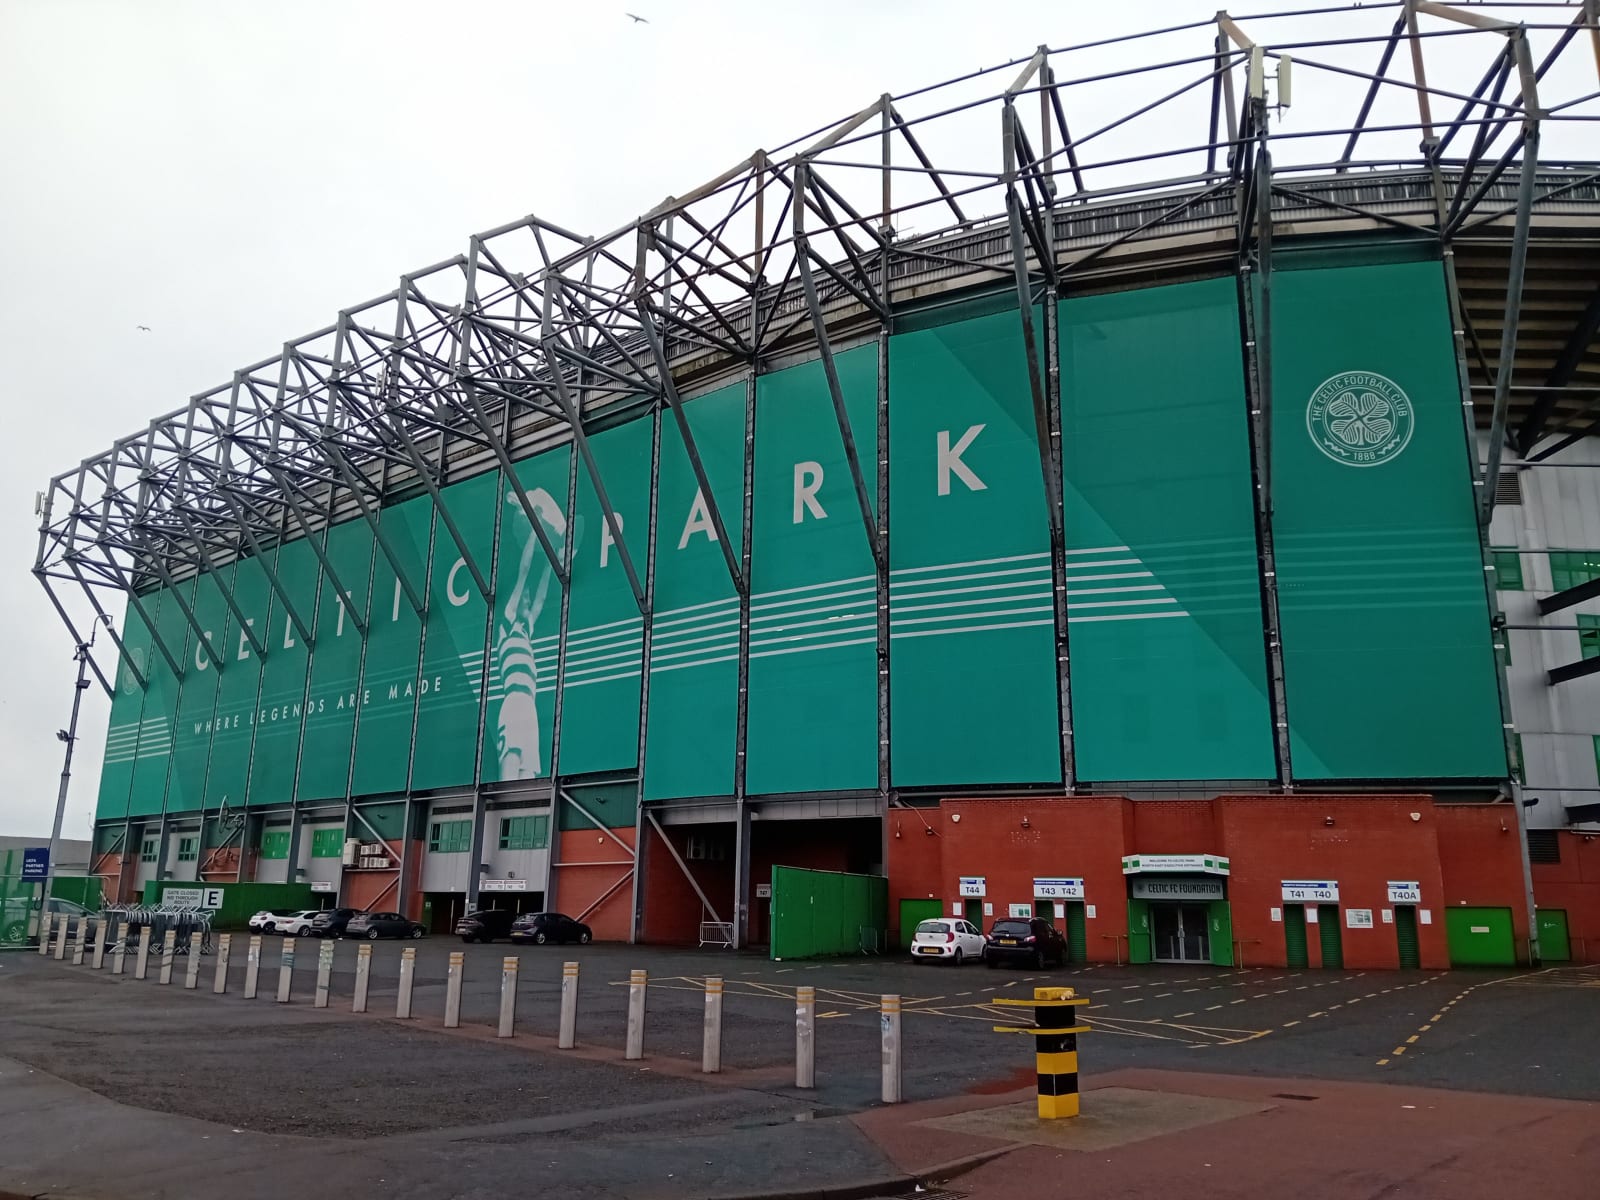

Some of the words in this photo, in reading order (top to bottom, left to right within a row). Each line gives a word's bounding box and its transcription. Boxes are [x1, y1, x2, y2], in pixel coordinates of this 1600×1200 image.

[1312, 405, 1323, 422] THE
[1319, 380, 1344, 405] CELTIC
[1344, 376, 1391, 395] FOOTBALL
[1391, 393, 1408, 417] CLUB
[1353, 452, 1376, 461] 1888
[600, 424, 989, 568] PARK
[194, 715, 240, 735] WHERE
[250, 699, 325, 725] LEGENDS
[336, 690, 371, 710] ARE
[388, 676, 442, 700] MADE
[965, 886, 980, 894] T44
[1040, 887, 1056, 895] T43
[1061, 887, 1077, 896] T42
[1147, 883, 1169, 894] CELTIC
[1169, 883, 1178, 894] FC
[1180, 883, 1221, 894] FOUNDATION
[207, 891, 219, 906] E
[1290, 890, 1305, 898] T41
[1313, 890, 1331, 899] T40
[1392, 891, 1417, 899] T40A
